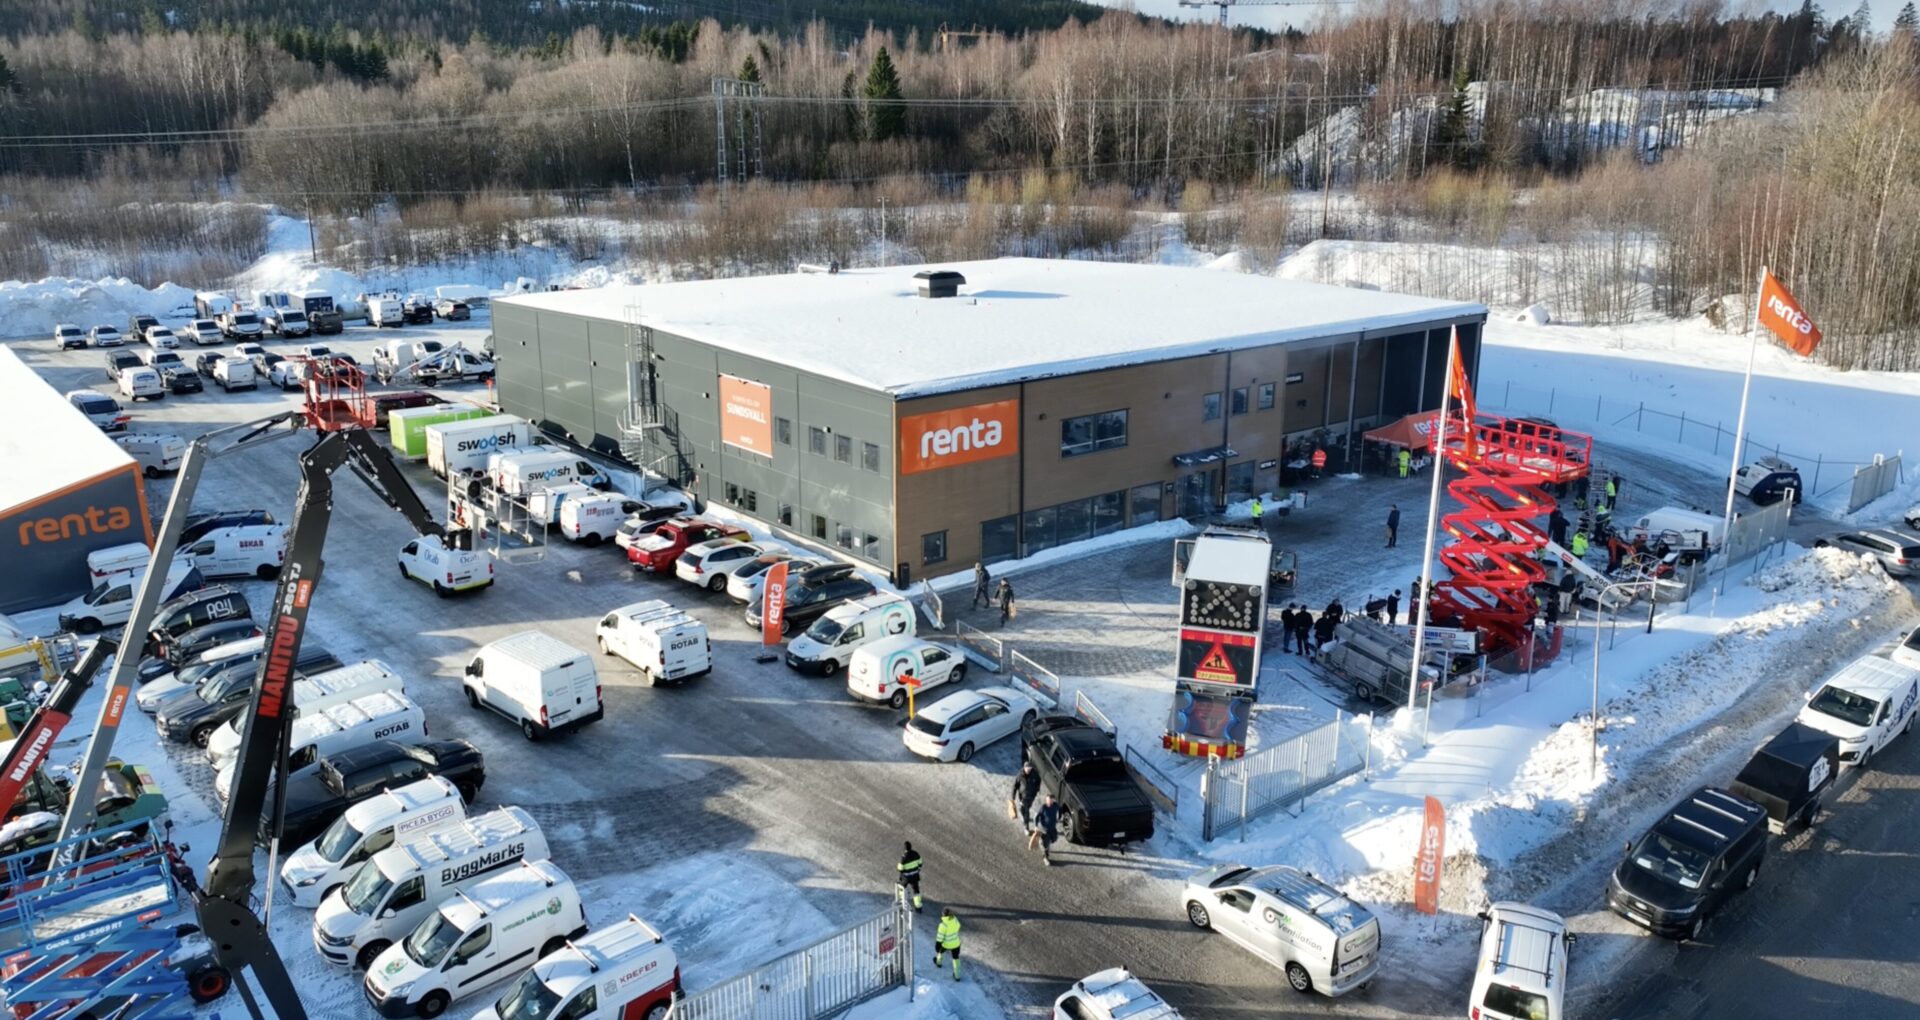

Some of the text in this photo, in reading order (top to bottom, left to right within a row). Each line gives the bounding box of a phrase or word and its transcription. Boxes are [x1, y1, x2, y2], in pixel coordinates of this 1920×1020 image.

[1767, 293, 1814, 336] renta
[457, 432, 516, 452] swoosh
[920, 417, 1002, 459] renta
[528, 466, 571, 481] swoosh
[18, 505, 131, 546] renta
[768, 583, 782, 625] renta
[257, 615, 299, 718] MANITOU
[282, 581, 298, 615] 280
[671, 637, 699, 651] ROTAB
[110, 694, 124, 718] renta
[374, 722, 410, 741] ROTAB
[10, 727, 53, 782] MANITOU
[400, 807, 452, 832] PICEA BYGG
[441, 842, 525, 883] ByggMarks
[619, 960, 658, 985] KAEFER
